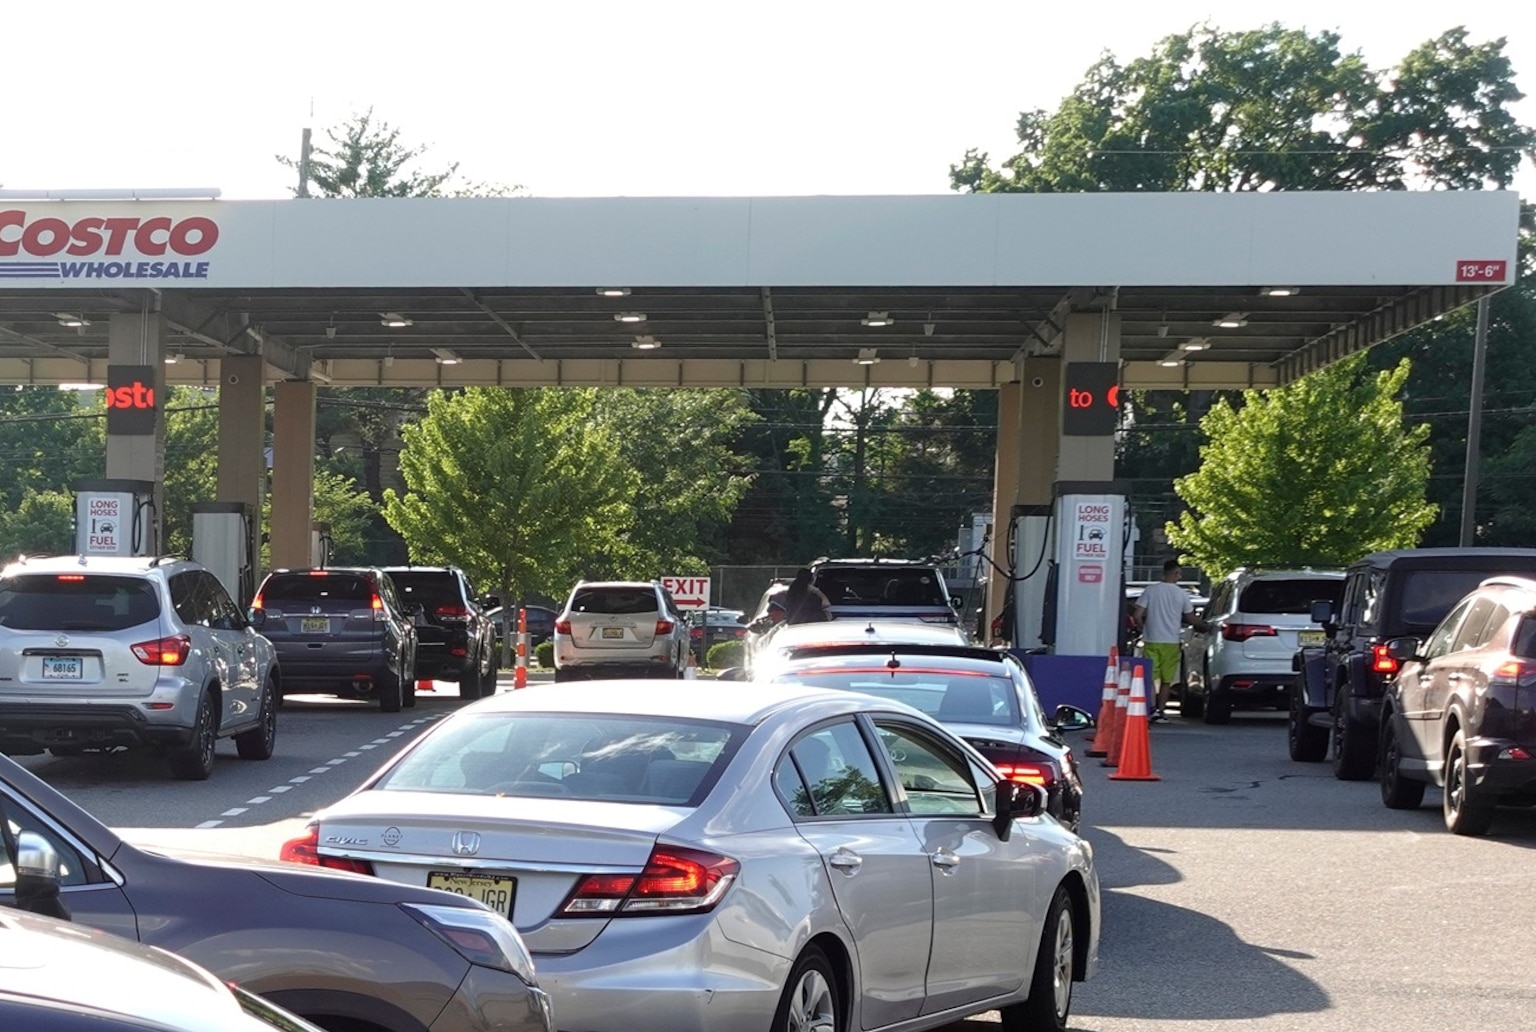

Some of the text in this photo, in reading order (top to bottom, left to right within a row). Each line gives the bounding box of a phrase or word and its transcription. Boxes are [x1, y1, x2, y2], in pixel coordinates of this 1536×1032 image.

[60, 261, 210, 278] WHOLESALE
[1070, 388, 1093, 408] to
[90, 500, 118, 509] LONG
[1078, 505, 1109, 514] LONG
[90, 509, 118, 517] HOSES
[1078, 514, 1109, 522] HOSES
[90, 536, 117, 546] FUEL
[1076, 543, 1106, 553] FUEL
[664, 579, 708, 595] EXIT
[326, 835, 369, 847] CIVIC
[449, 877, 493, 888] New Jersey
